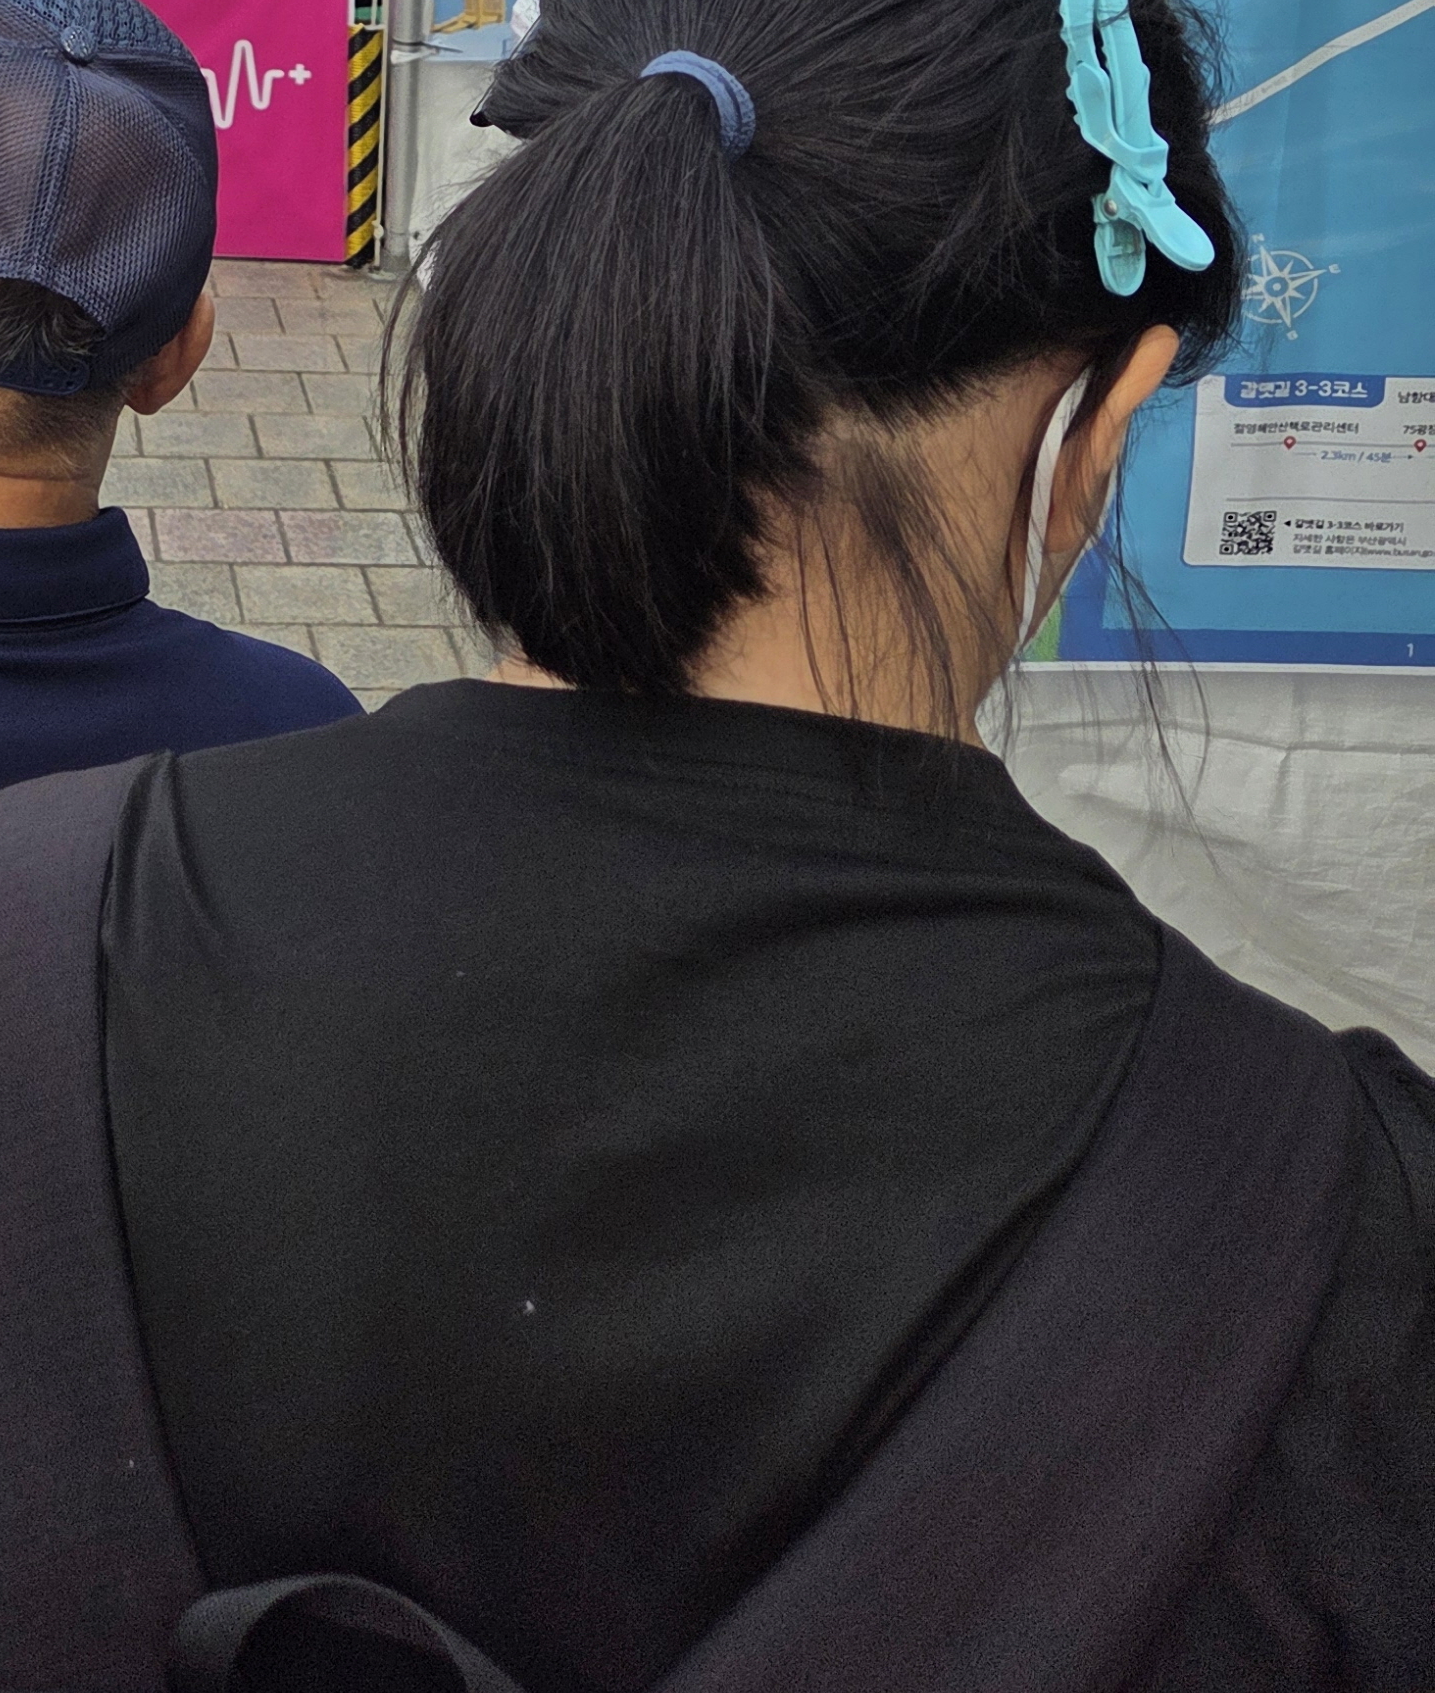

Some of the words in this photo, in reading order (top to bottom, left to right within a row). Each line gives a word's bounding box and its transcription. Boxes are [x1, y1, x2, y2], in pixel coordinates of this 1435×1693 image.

[1294, 380, 1368, 398] 3-3코스
[1327, 520, 1363, 530] 3-3코스
[1364, 521, 1405, 533] 바로가기
[1406, 642, 1414, 658] 1
